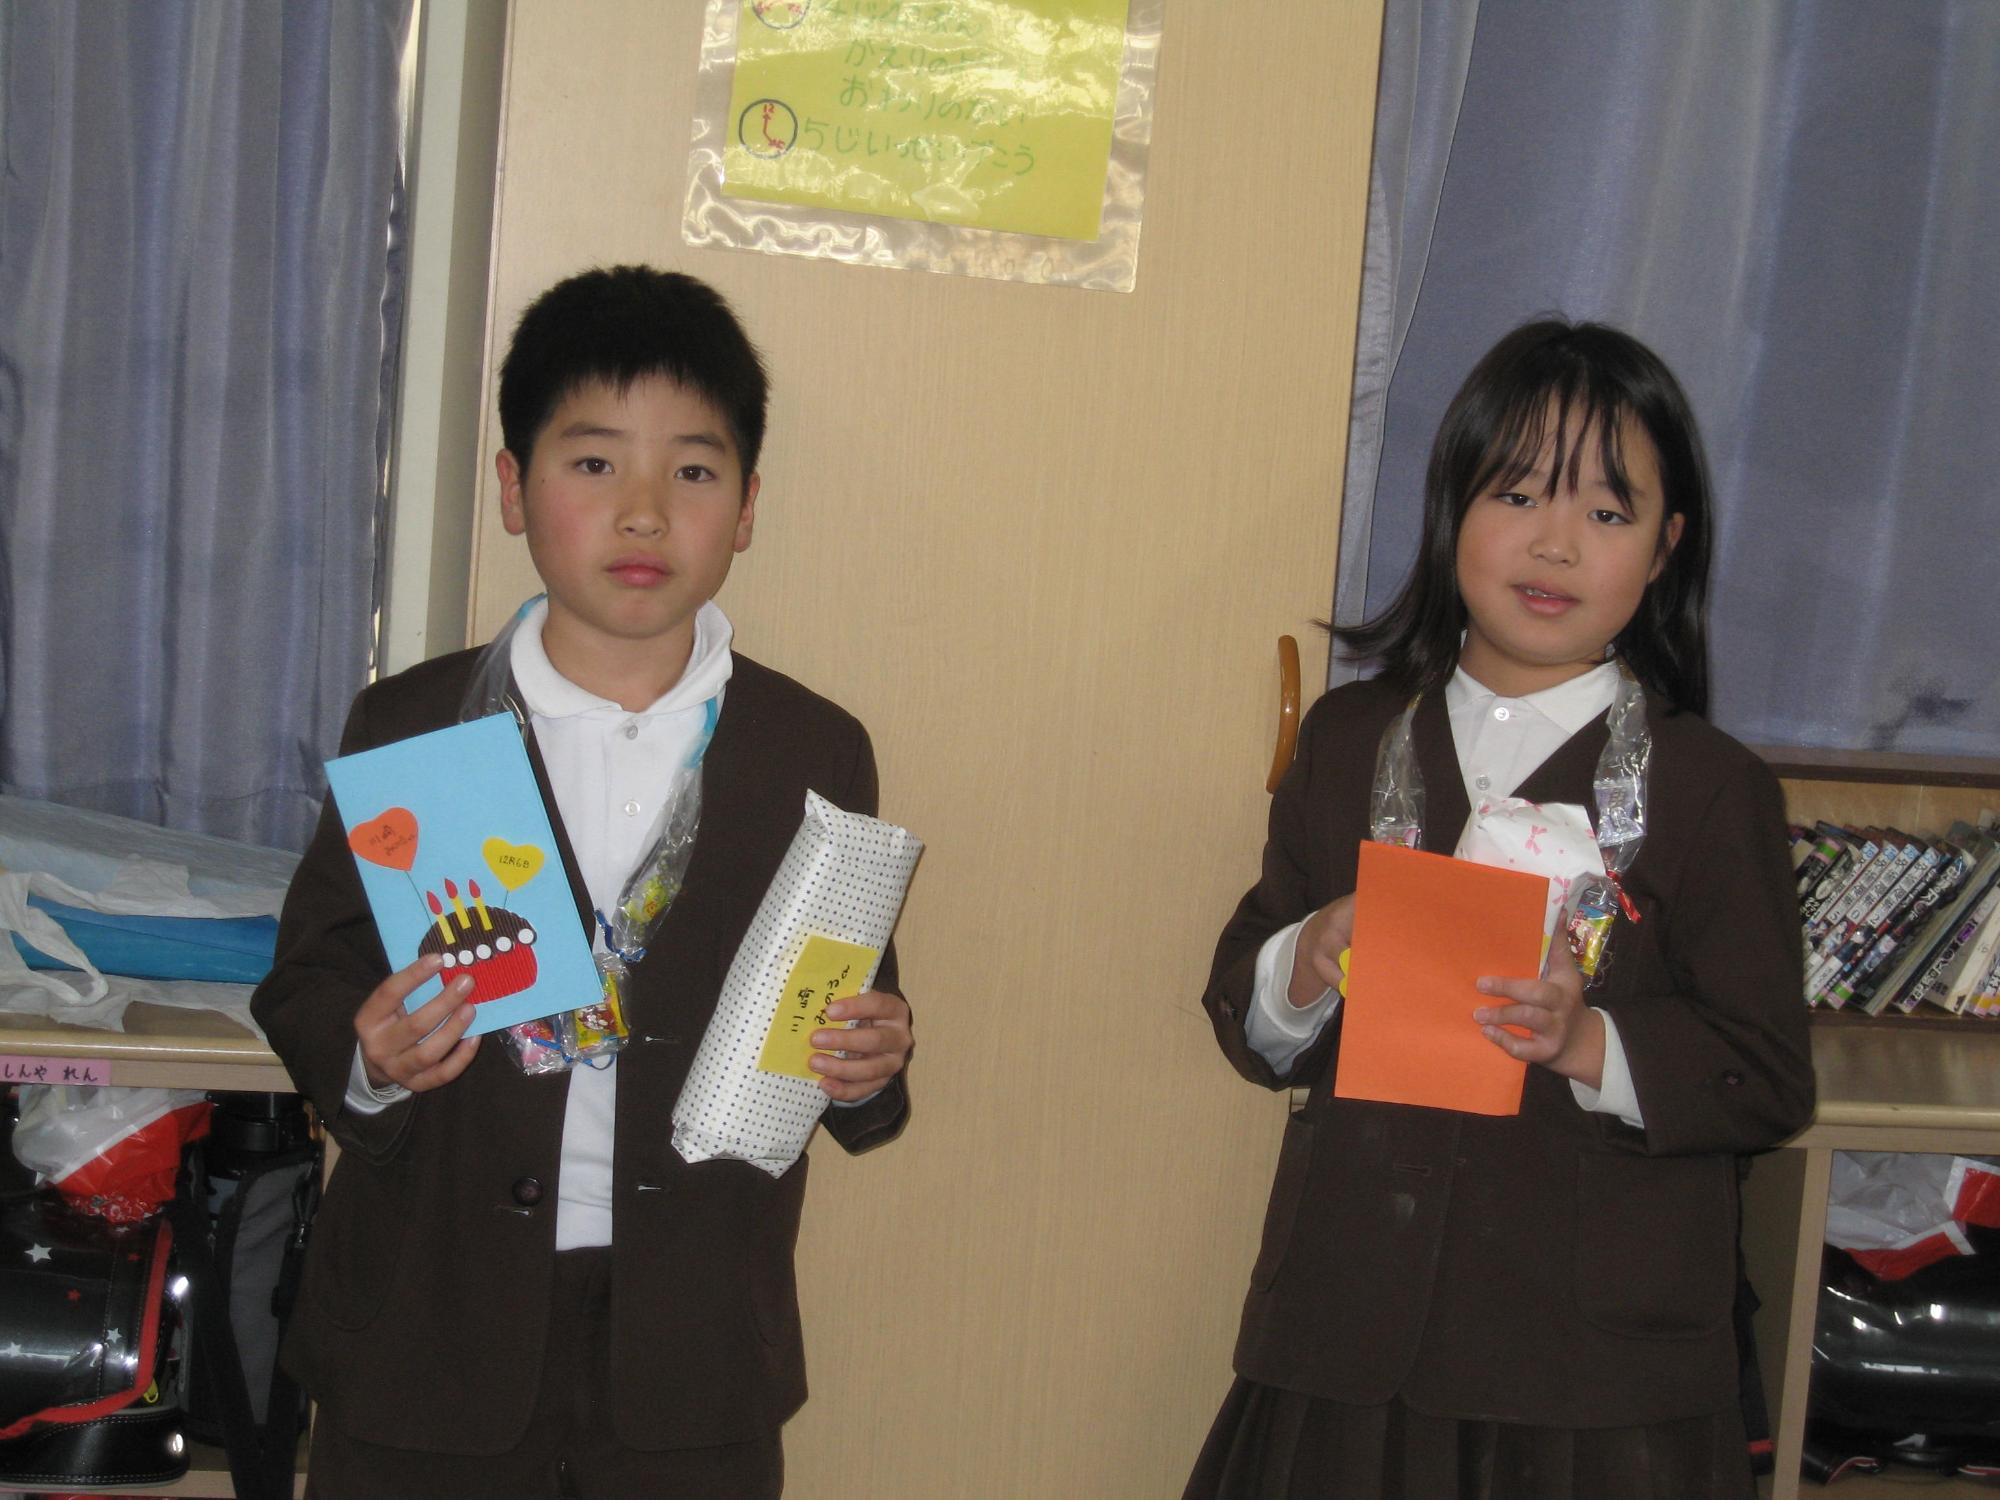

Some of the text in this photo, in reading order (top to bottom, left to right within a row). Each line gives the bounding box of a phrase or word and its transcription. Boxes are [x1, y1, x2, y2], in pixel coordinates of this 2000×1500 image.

[4, 1063, 98, 1082] しんや れん
